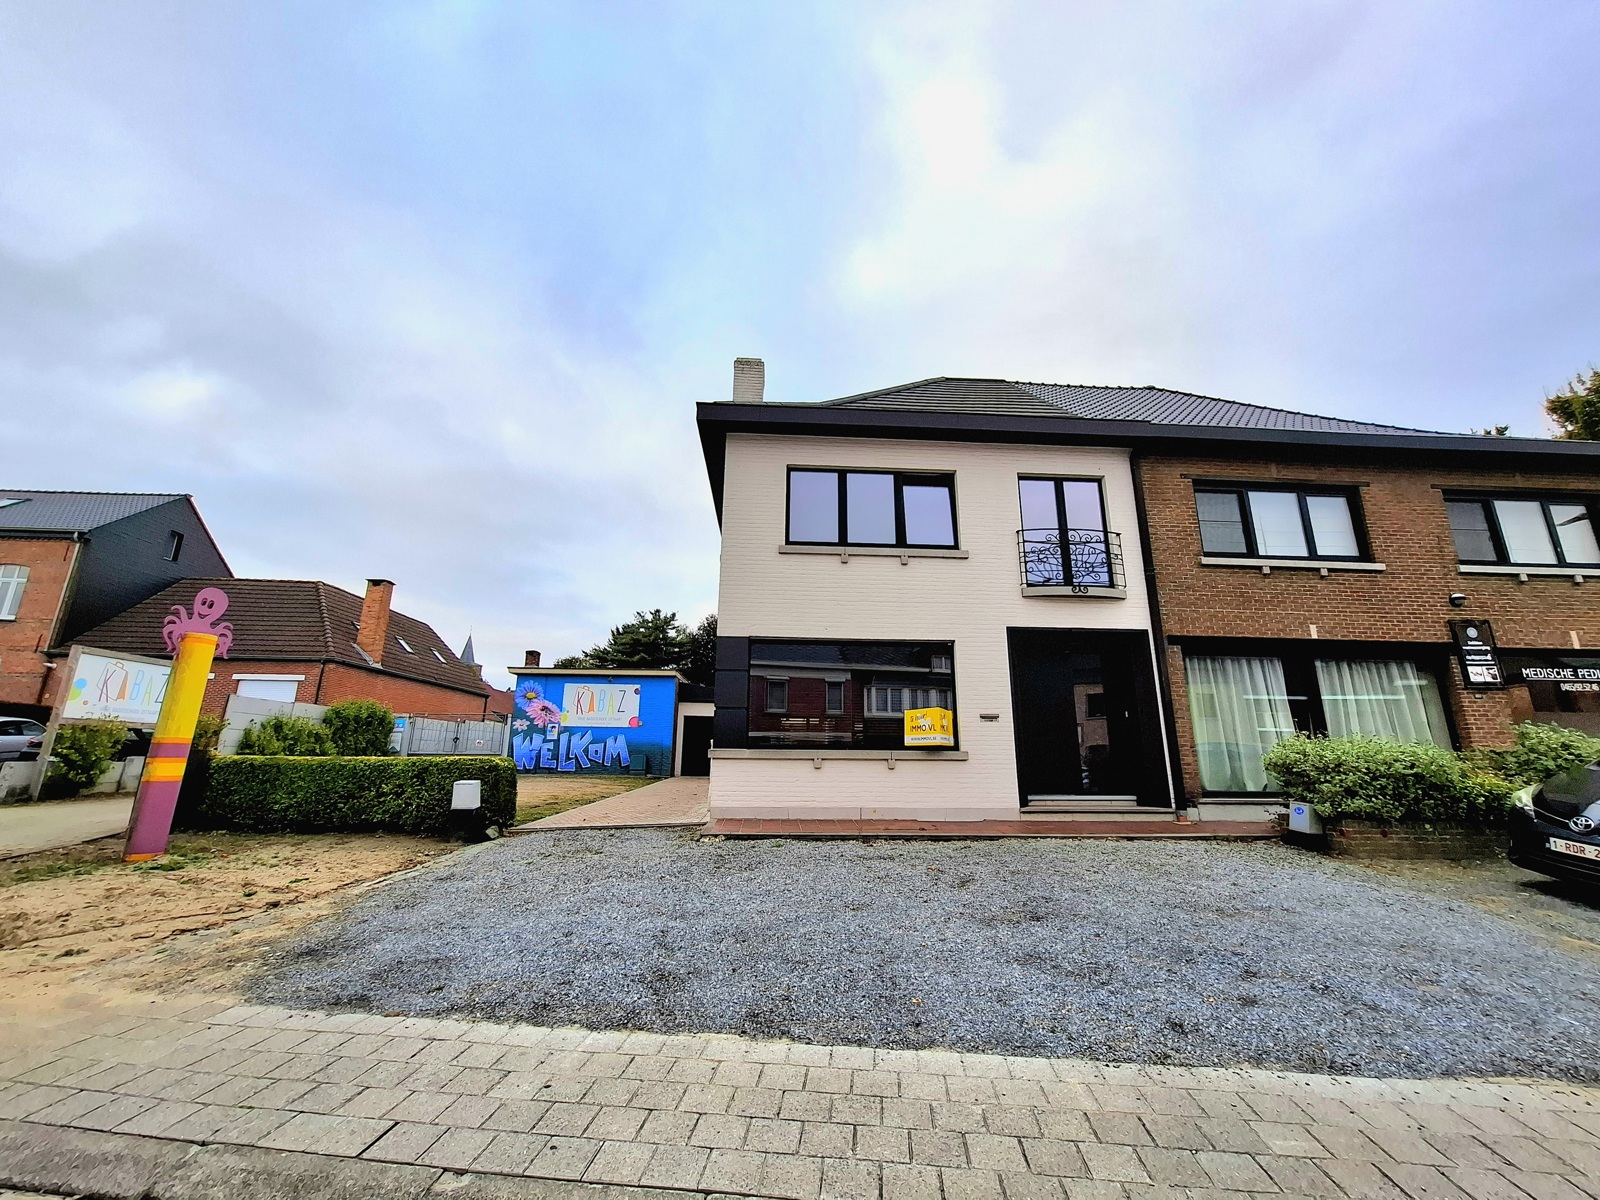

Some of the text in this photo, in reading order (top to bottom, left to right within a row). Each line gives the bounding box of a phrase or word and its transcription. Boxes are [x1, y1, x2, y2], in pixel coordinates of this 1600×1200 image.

[1521, 667, 1575, 679] MEDISCHE
[573, 686, 626, 715] KABAZ
[910, 724, 927, 732] IMMO
[927, 723, 937, 732] VL
[512, 730, 631, 771] WELKOM
